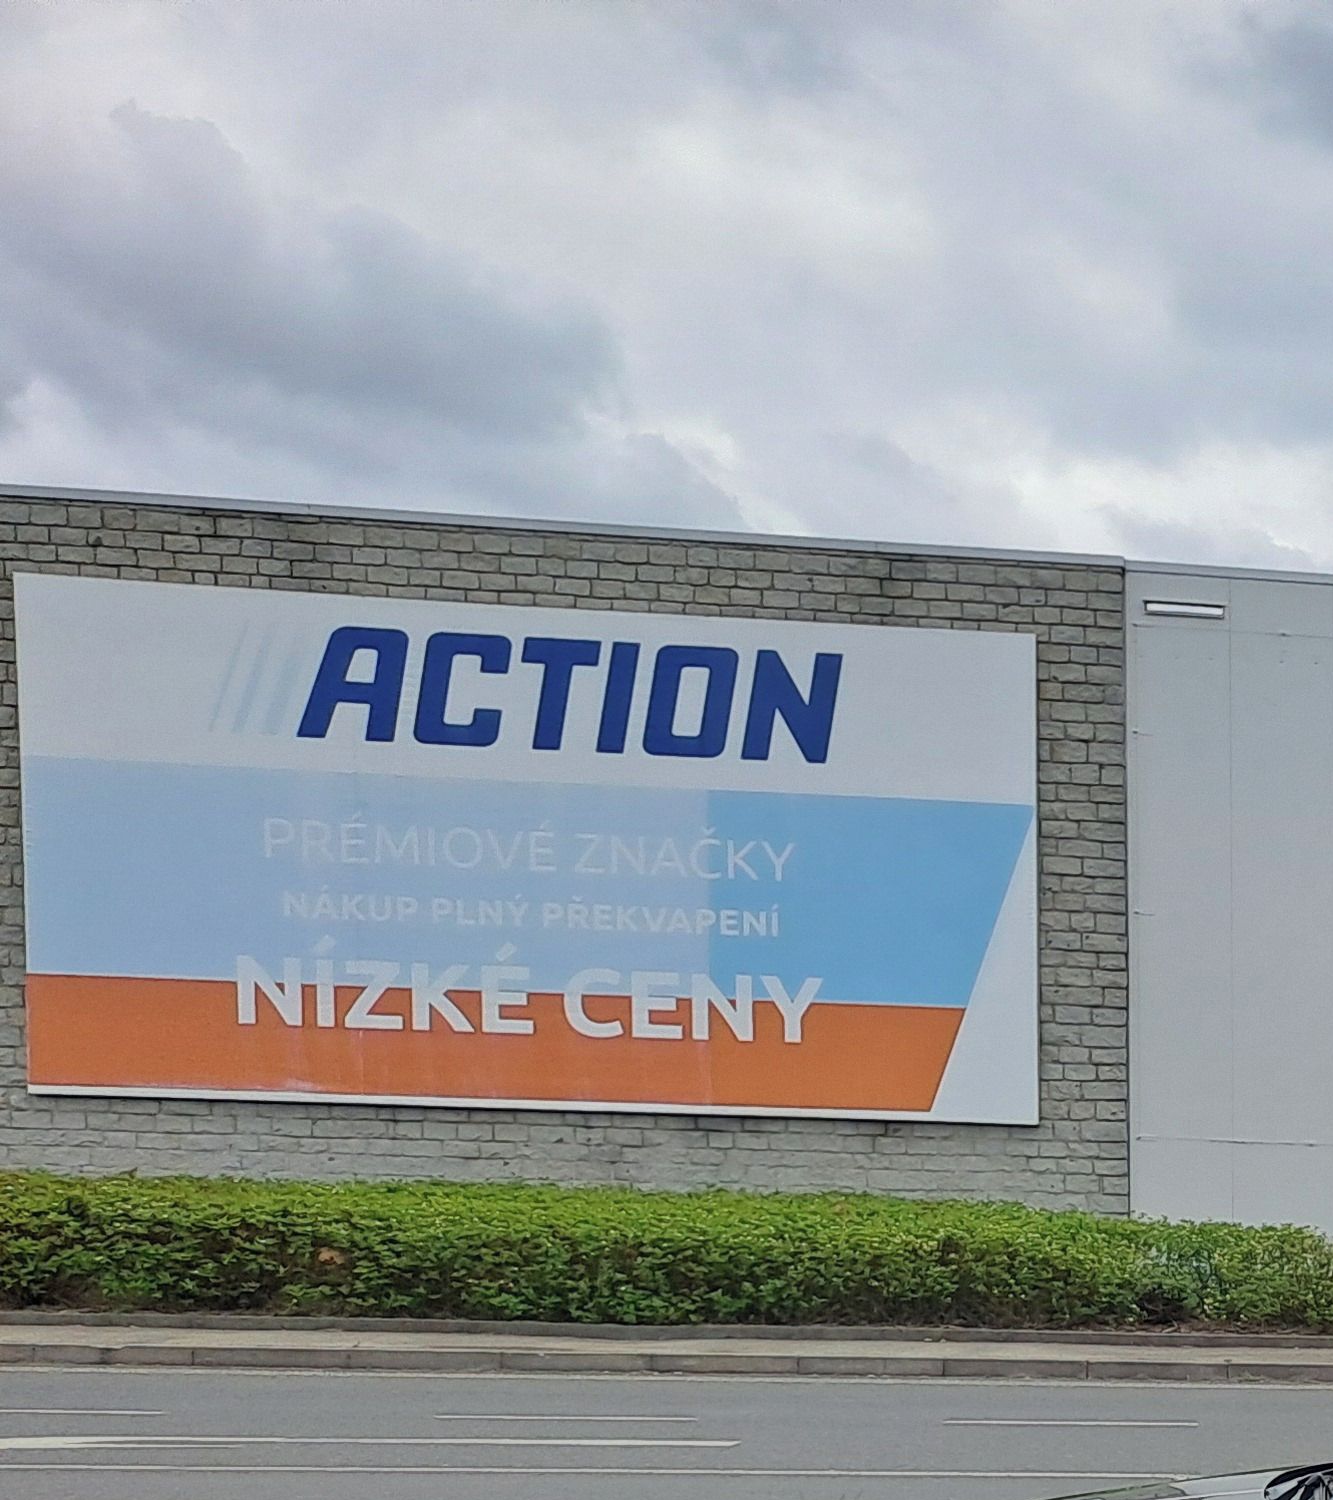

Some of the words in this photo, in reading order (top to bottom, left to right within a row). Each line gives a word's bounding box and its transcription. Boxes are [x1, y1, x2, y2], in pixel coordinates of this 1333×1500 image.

[296, 626, 843, 764] ACTION
[262, 812, 558, 873] PRÉMIOVÉ
[574, 827, 795, 882] ZNAČKY
[282, 884, 418, 923] NÁKUP
[432, 893, 528, 928] PLNÝ
[542, 897, 780, 938] PŘEKVAPENÍ
[236, 934, 536, 1036] NÍZKÉ
[563, 967, 824, 1044] CENY
